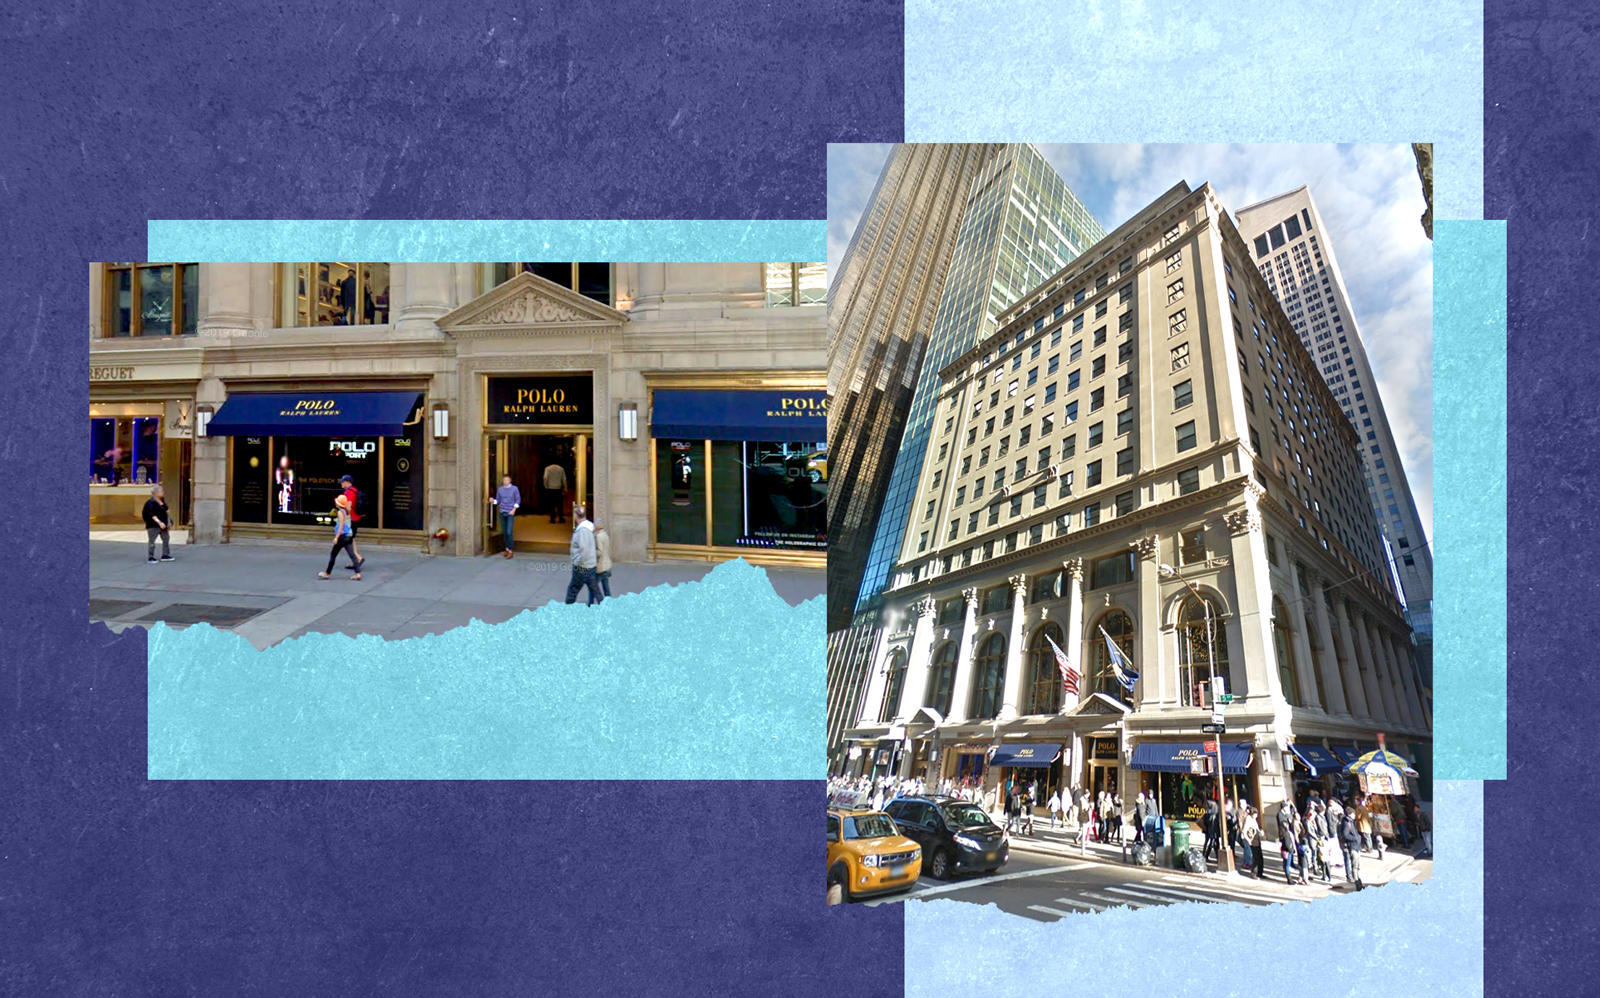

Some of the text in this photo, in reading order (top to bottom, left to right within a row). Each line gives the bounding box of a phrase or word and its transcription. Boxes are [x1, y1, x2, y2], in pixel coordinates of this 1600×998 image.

[517, 388, 565, 404] POLO
[295, 399, 335, 410] POLO
[503, 404, 578, 413] RALPH LAUREN
[280, 409, 340, 417] RALPH LAUREN
[329, 441, 375, 453] POLO
[1187, 806, 1206, 815] POLO
